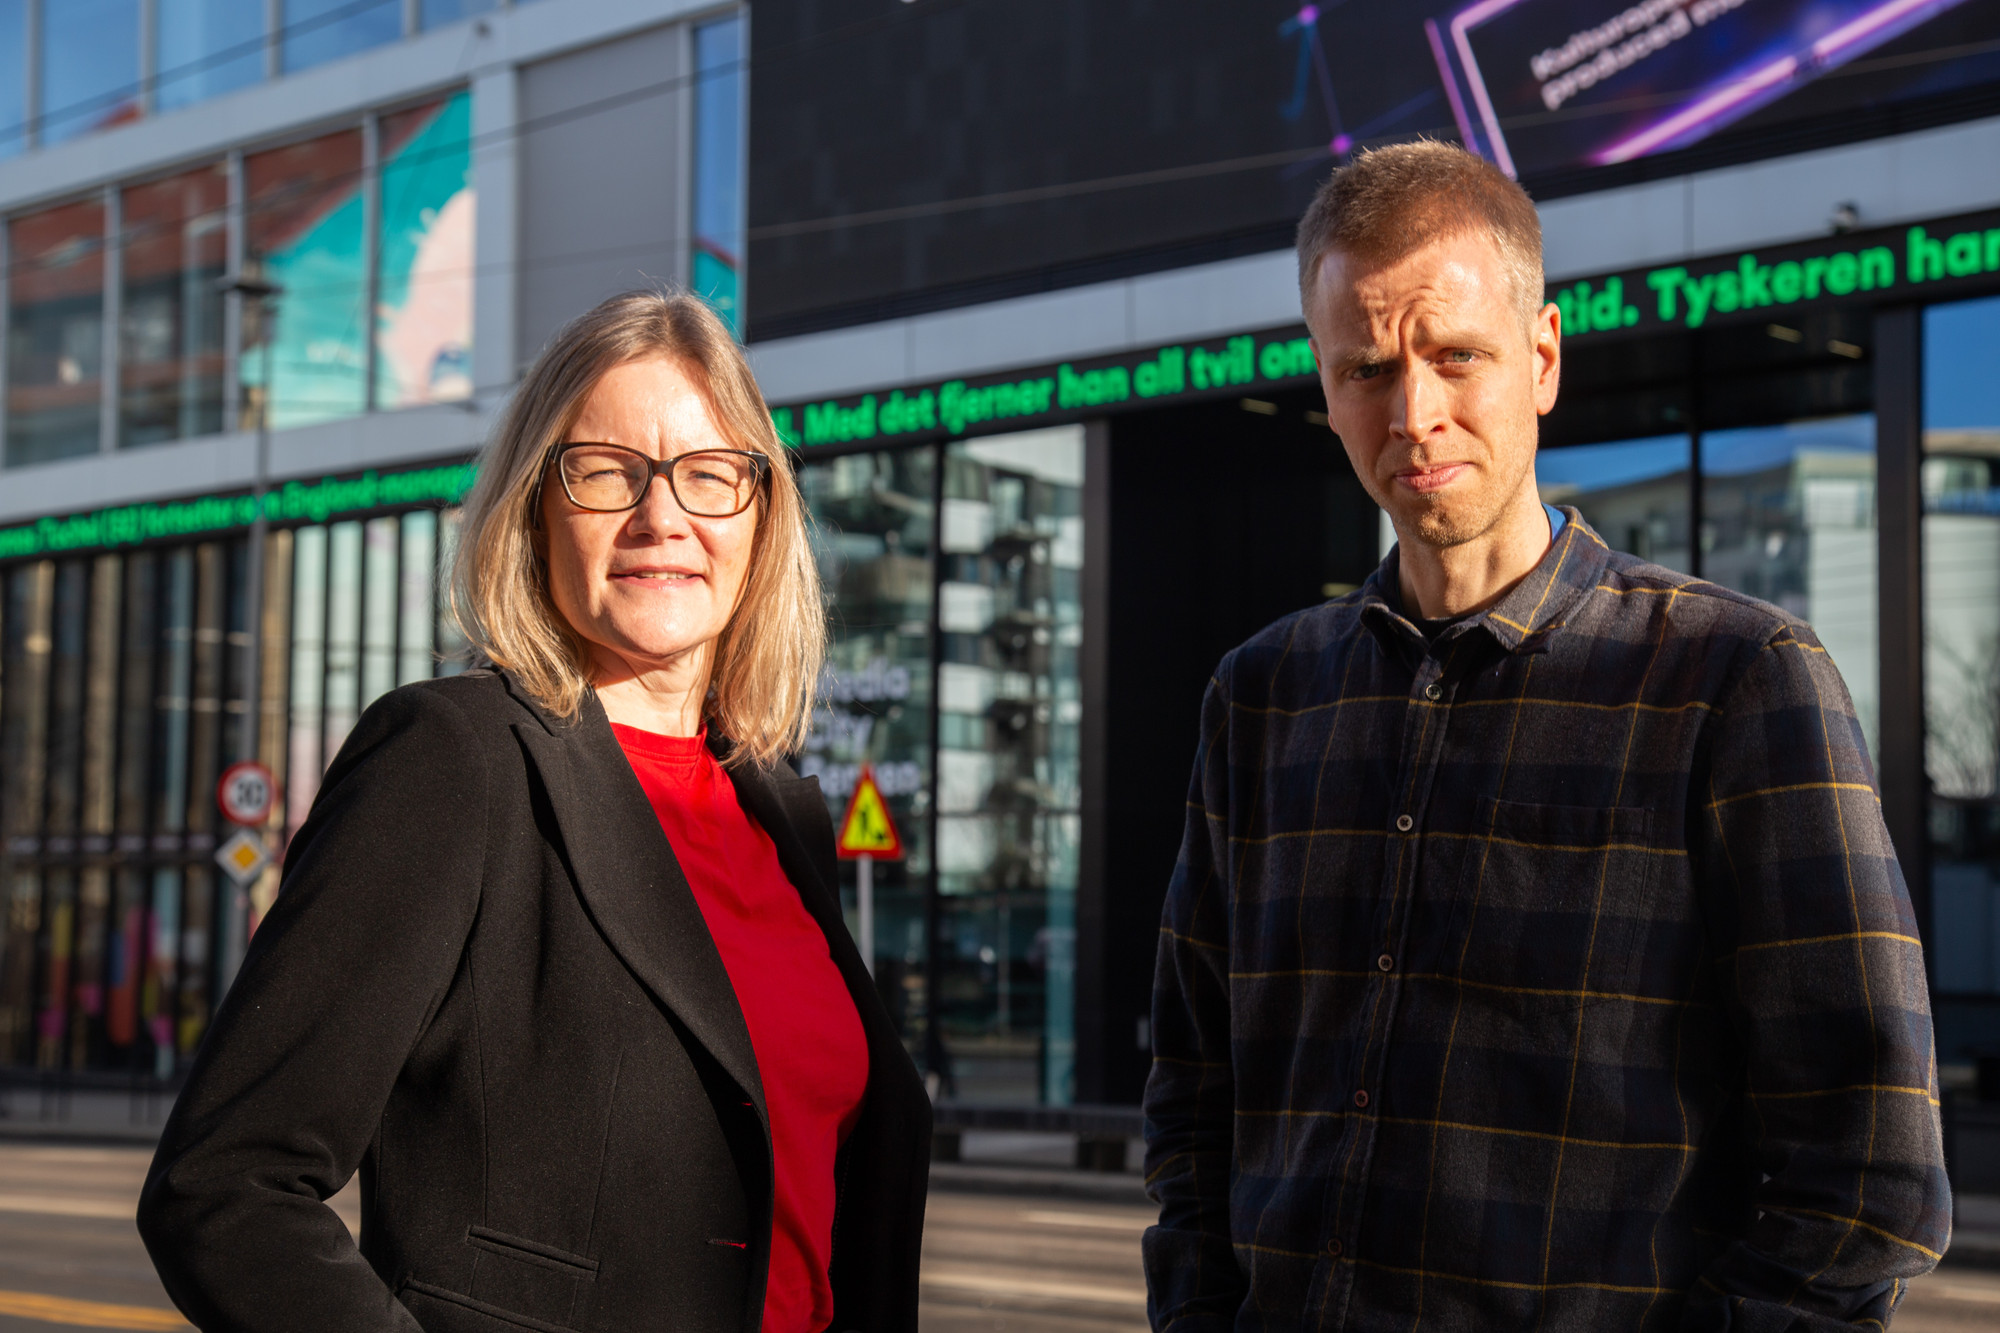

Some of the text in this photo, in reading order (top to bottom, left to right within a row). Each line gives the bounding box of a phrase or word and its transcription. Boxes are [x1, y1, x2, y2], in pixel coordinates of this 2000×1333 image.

[1541, 8, 1692, 111] produced
[803, 393, 877, 446] Med
[878, 389, 936, 435] det
[938, 379, 1056, 434] fjerner
[1057, 363, 1131, 410] han
[1133, 345, 1186, 398] all
[1187, 334, 1256, 390] tvil
[1544, 274, 1640, 337] tid.
[1646, 246, 1896, 328] Tyskeren
